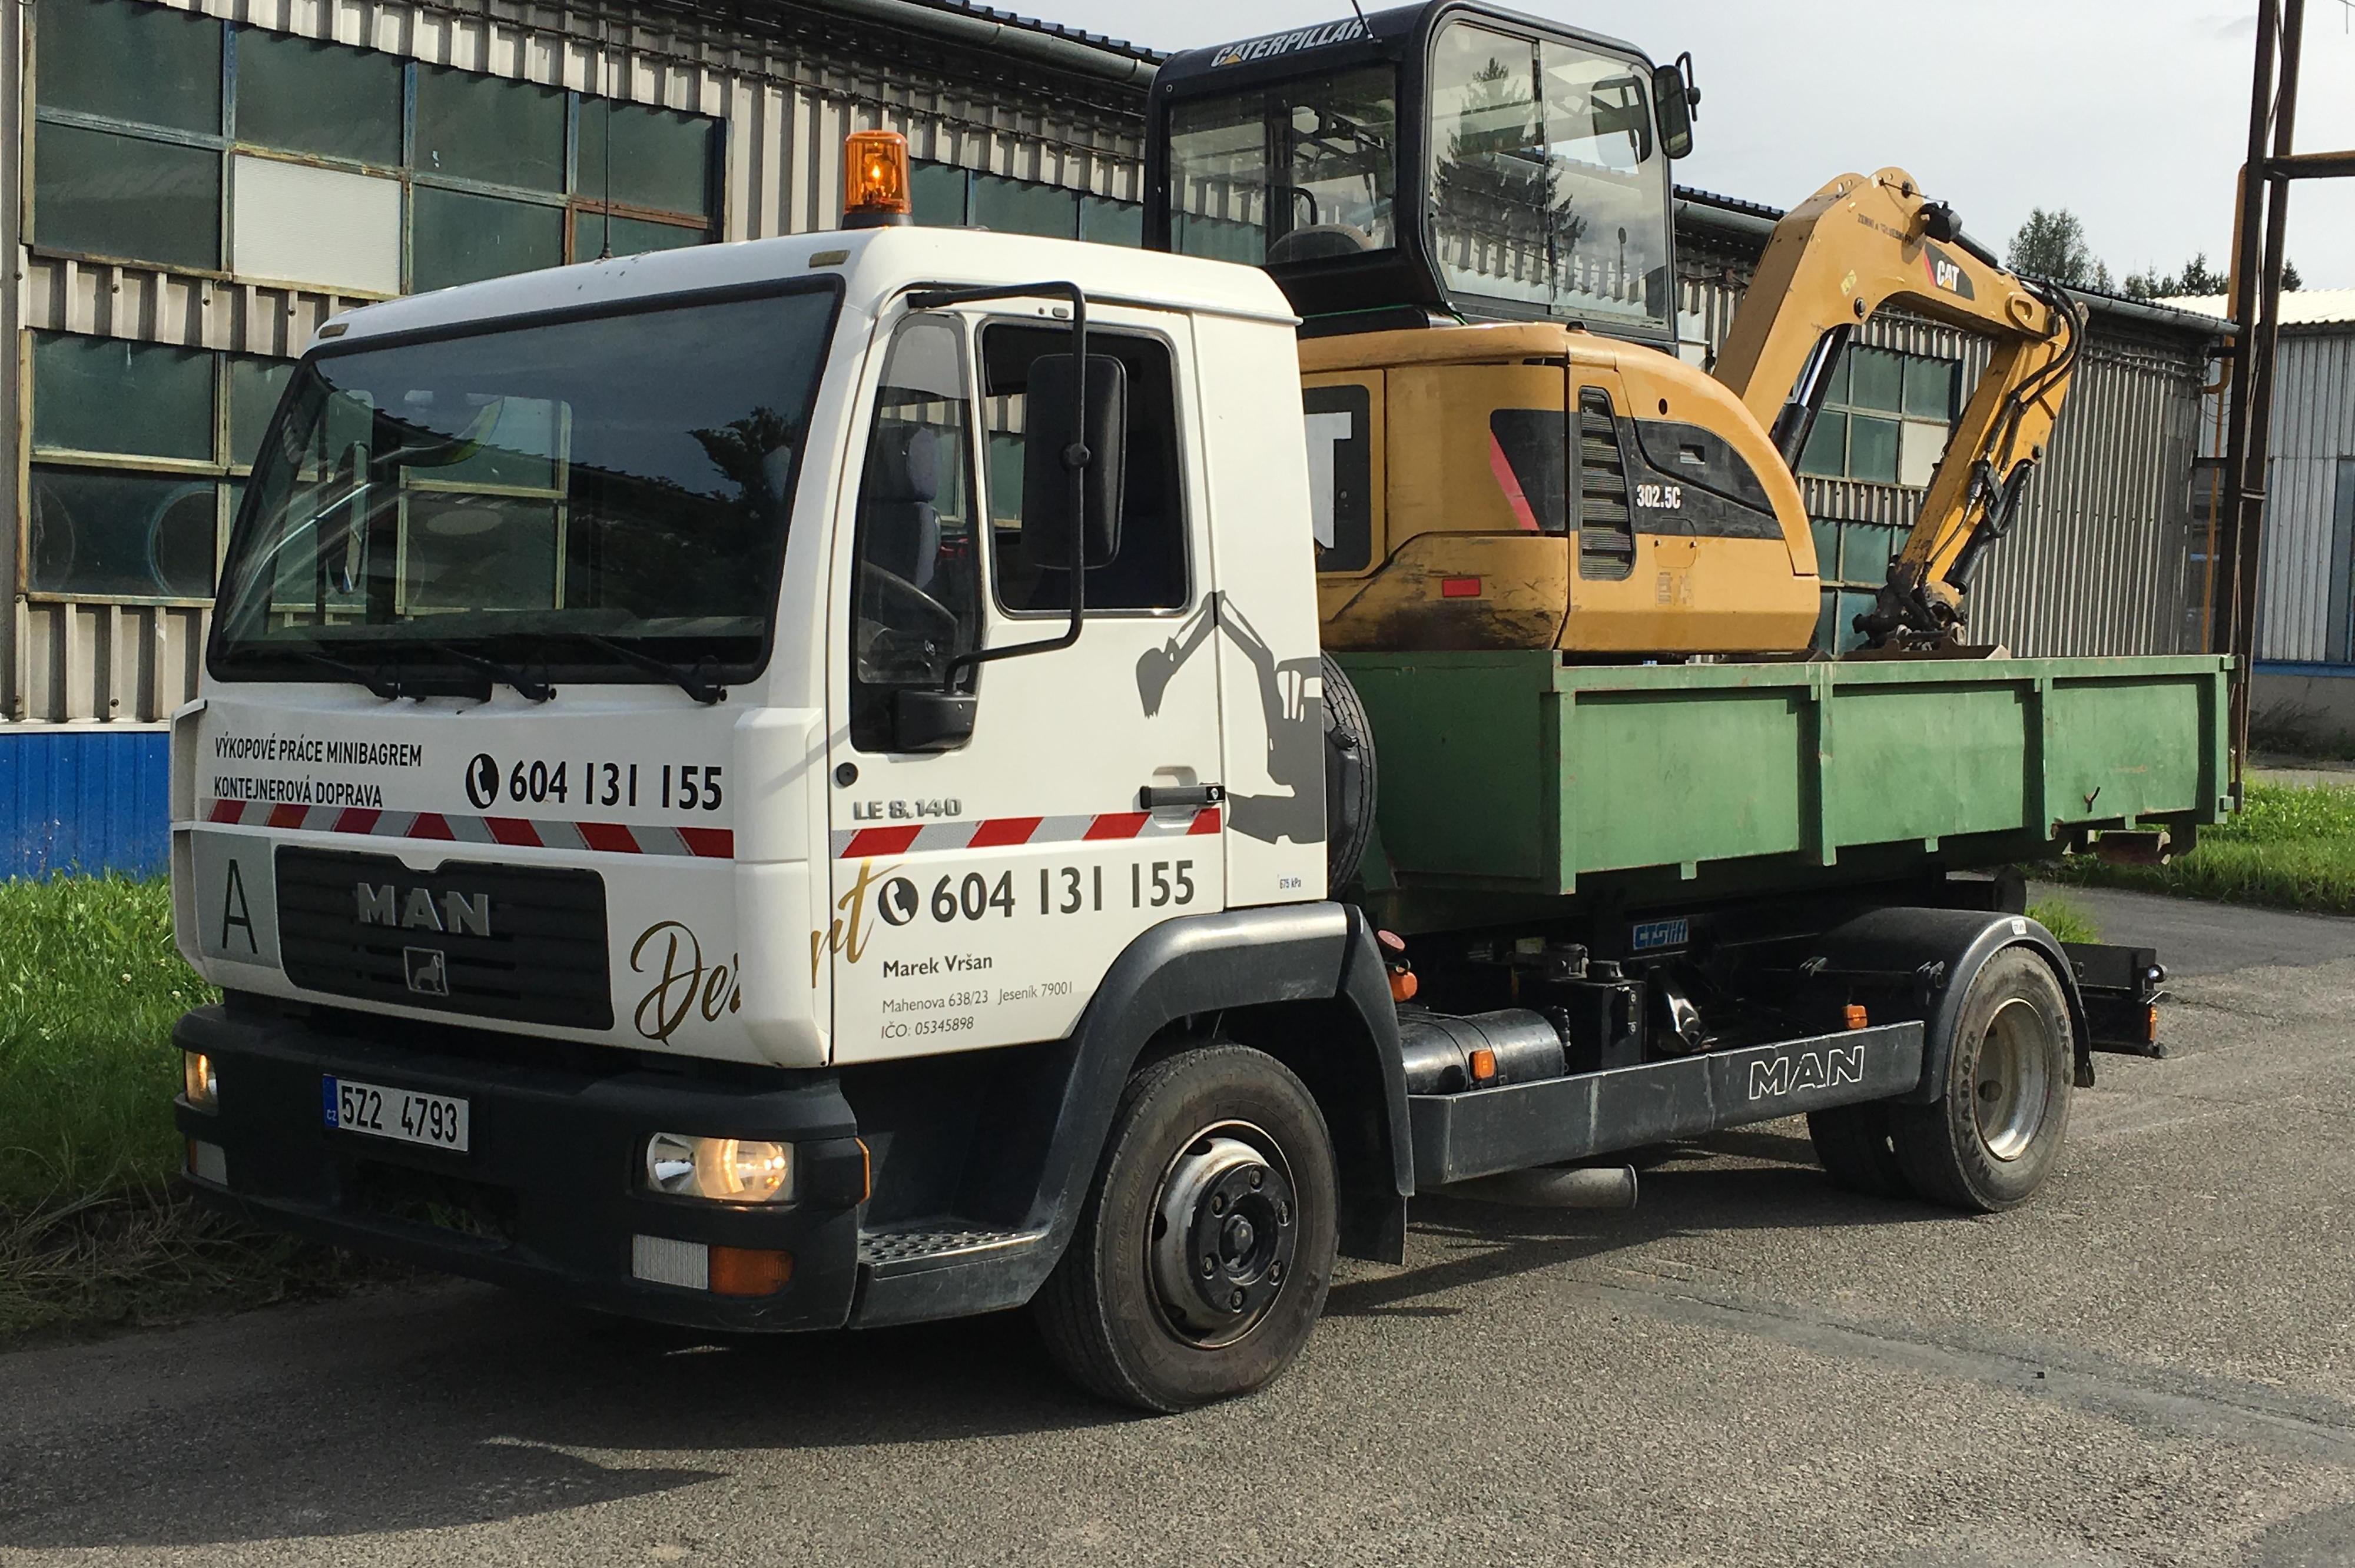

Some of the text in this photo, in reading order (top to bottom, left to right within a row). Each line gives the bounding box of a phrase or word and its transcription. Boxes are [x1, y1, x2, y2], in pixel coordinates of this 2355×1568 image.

[1936, 260, 1959, 291] CAT
[1637, 484, 1681, 509] 302.5C
[215, 731, 422, 766] VÝKOPOVÉ PRÁCE MINIBAGREM
[214, 775, 383, 807] KONTEJNEROVÁ DOPRAVA
[510, 760, 722, 810] 604 131 155
[854, 798, 962, 820] LE 8.140
[222, 859, 258, 954] A
[931, 859, 1194, 923] 604 131 155
[357, 883, 490, 936] MAN
[883, 953, 993, 978] Marek Vršan
[883, 981, 1073, 1014] Mahenova 638/23 Jeseník 79001
[881, 1016, 974, 1039] IČO: 05345898
[1749, 1045, 1864, 1100] MAN
[327, 1085, 457, 1142] CZ 5Z2 4793
